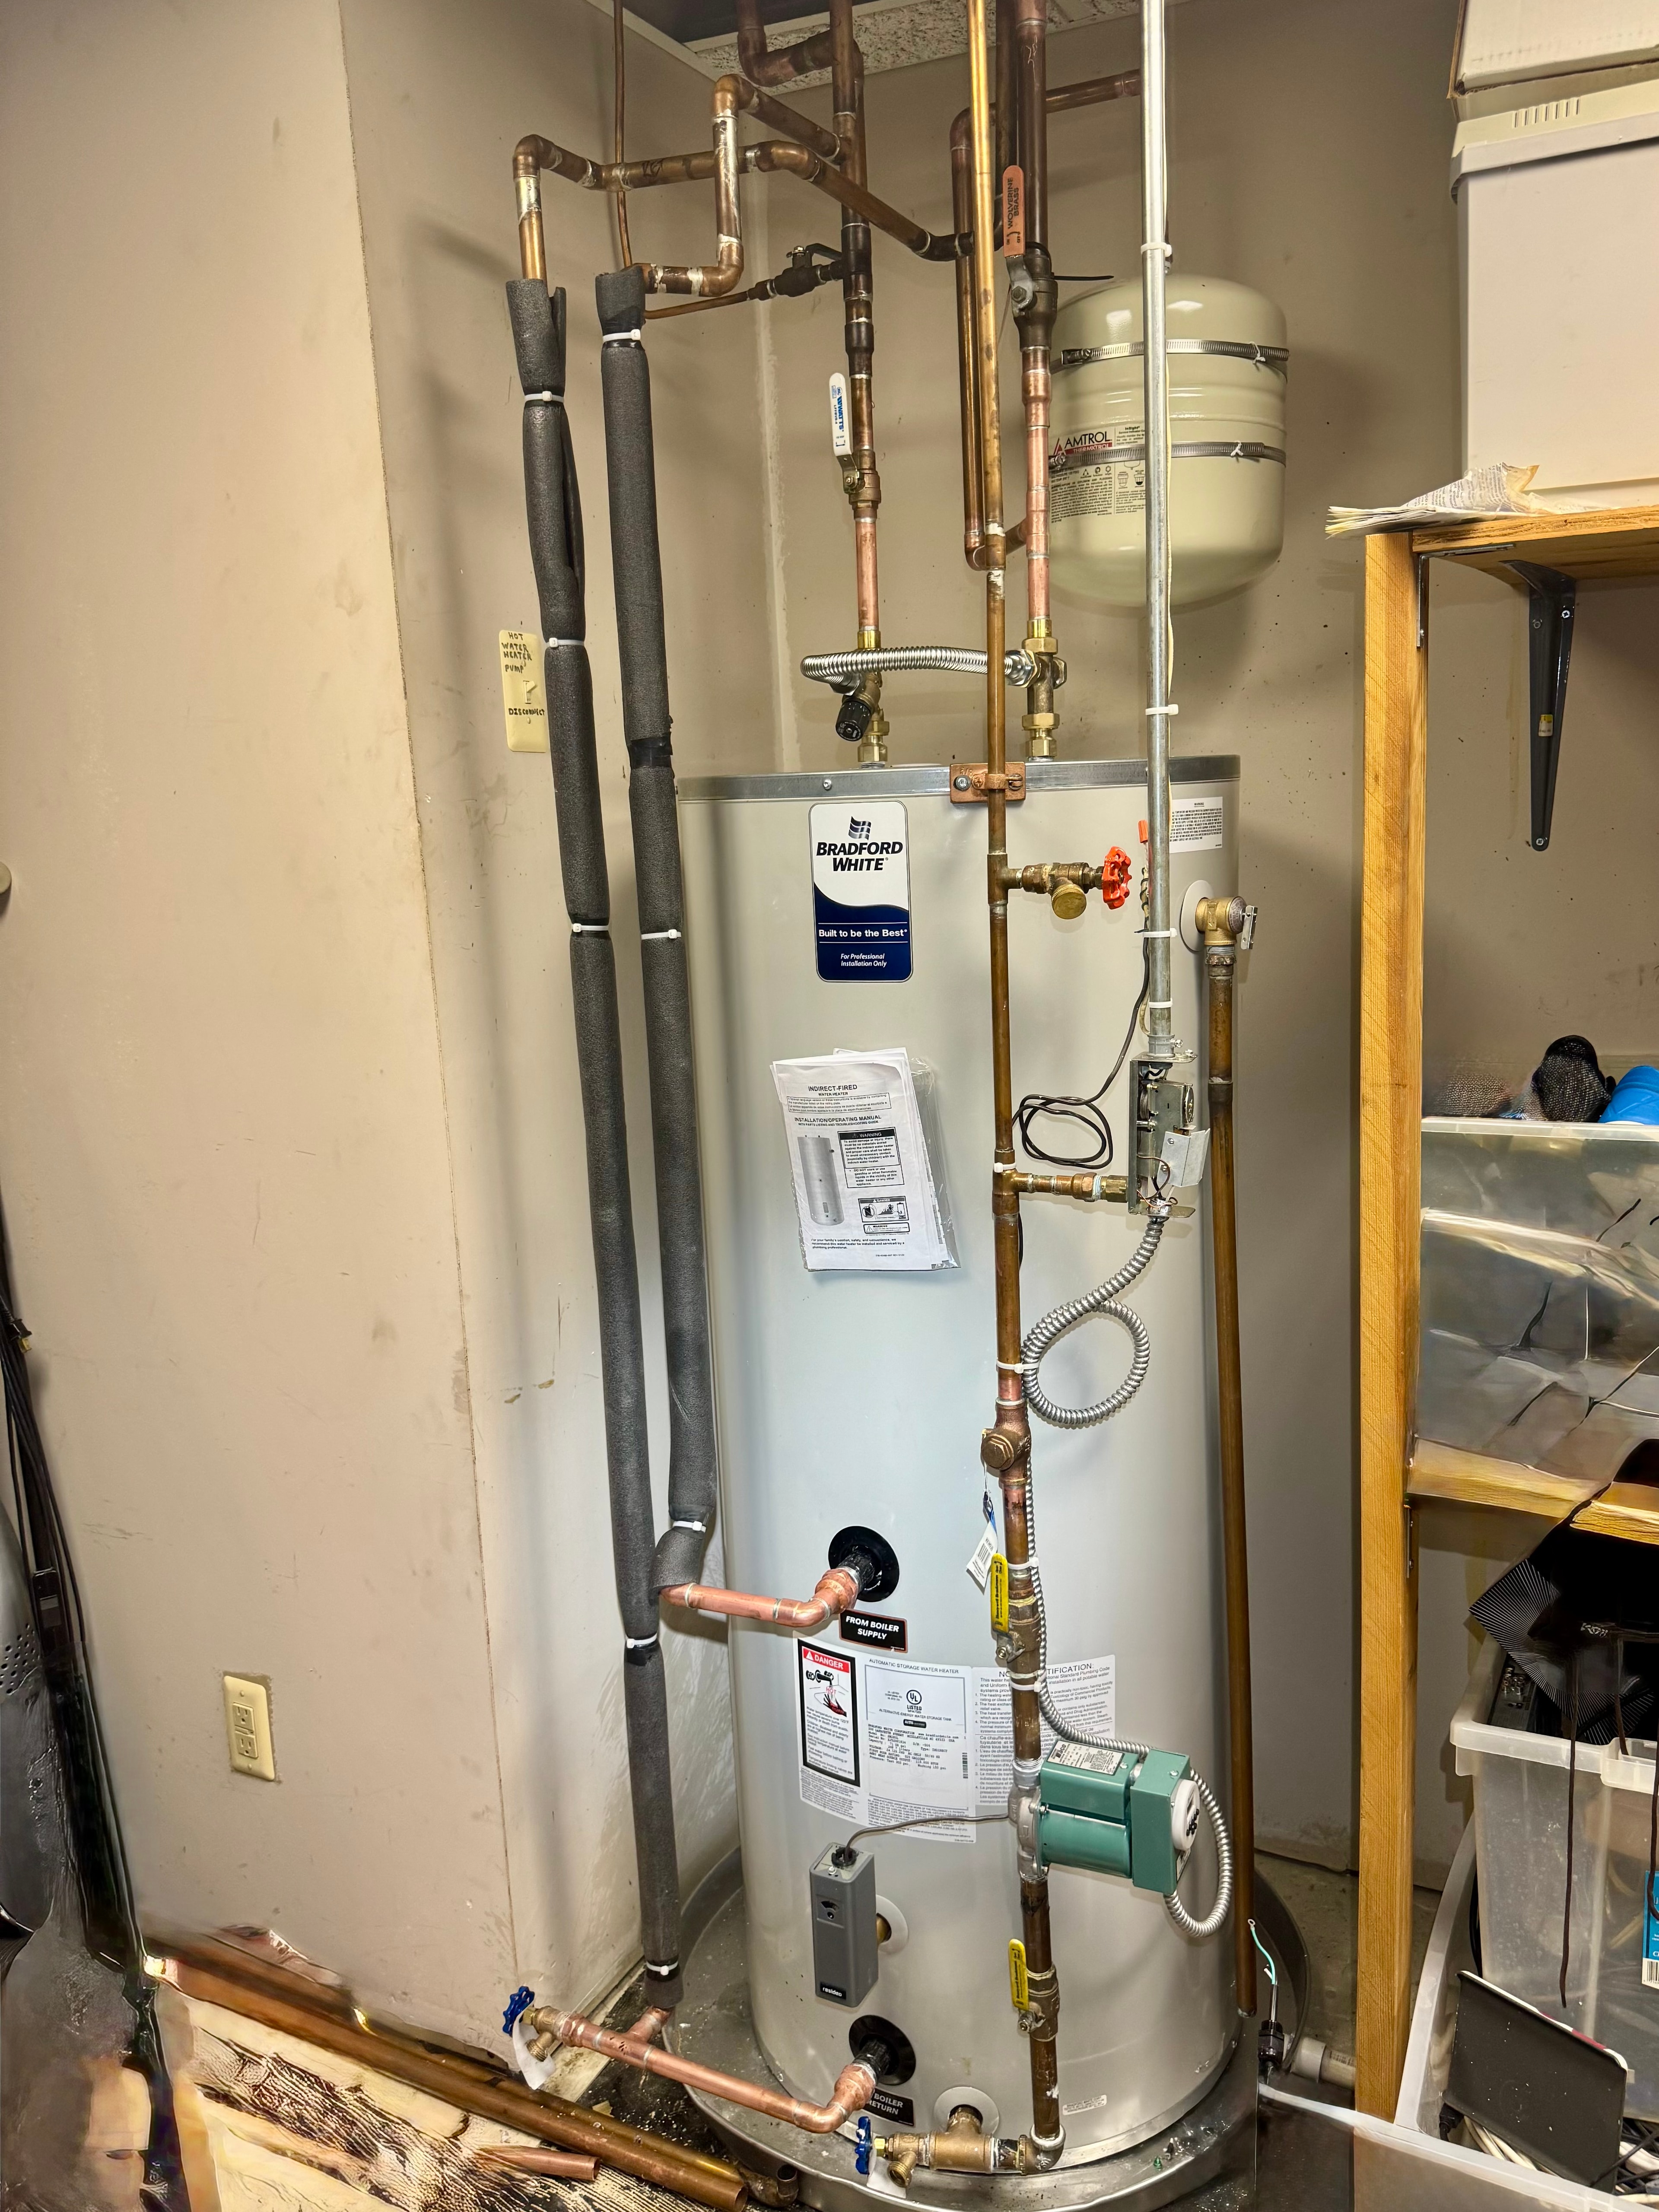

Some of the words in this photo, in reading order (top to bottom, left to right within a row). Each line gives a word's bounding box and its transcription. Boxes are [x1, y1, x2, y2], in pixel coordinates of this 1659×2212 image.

[1065, 431, 1111, 449] AMTROL
[508, 632, 523, 641] HOT
[502, 642, 528, 653] WATER
[503, 651, 532, 661] HEATER
[505, 664, 524, 674] PUMP
[816, 842, 903, 856] BRADFORD
[833, 857, 884, 871] WHITE
[845, 1615, 869, 1627] FROM
[870, 1621, 899, 1632] BOILER
[857, 1628, 887, 1640] SUPPLY
[814, 1654, 843, 1669] DANGER
[869, 1658, 896, 1667] AUTOMATIC
[822, 1986, 842, 1997] resideo
[869, 2099, 899, 2115] RETURN
[874, 2093, 903, 2108] BOILER
